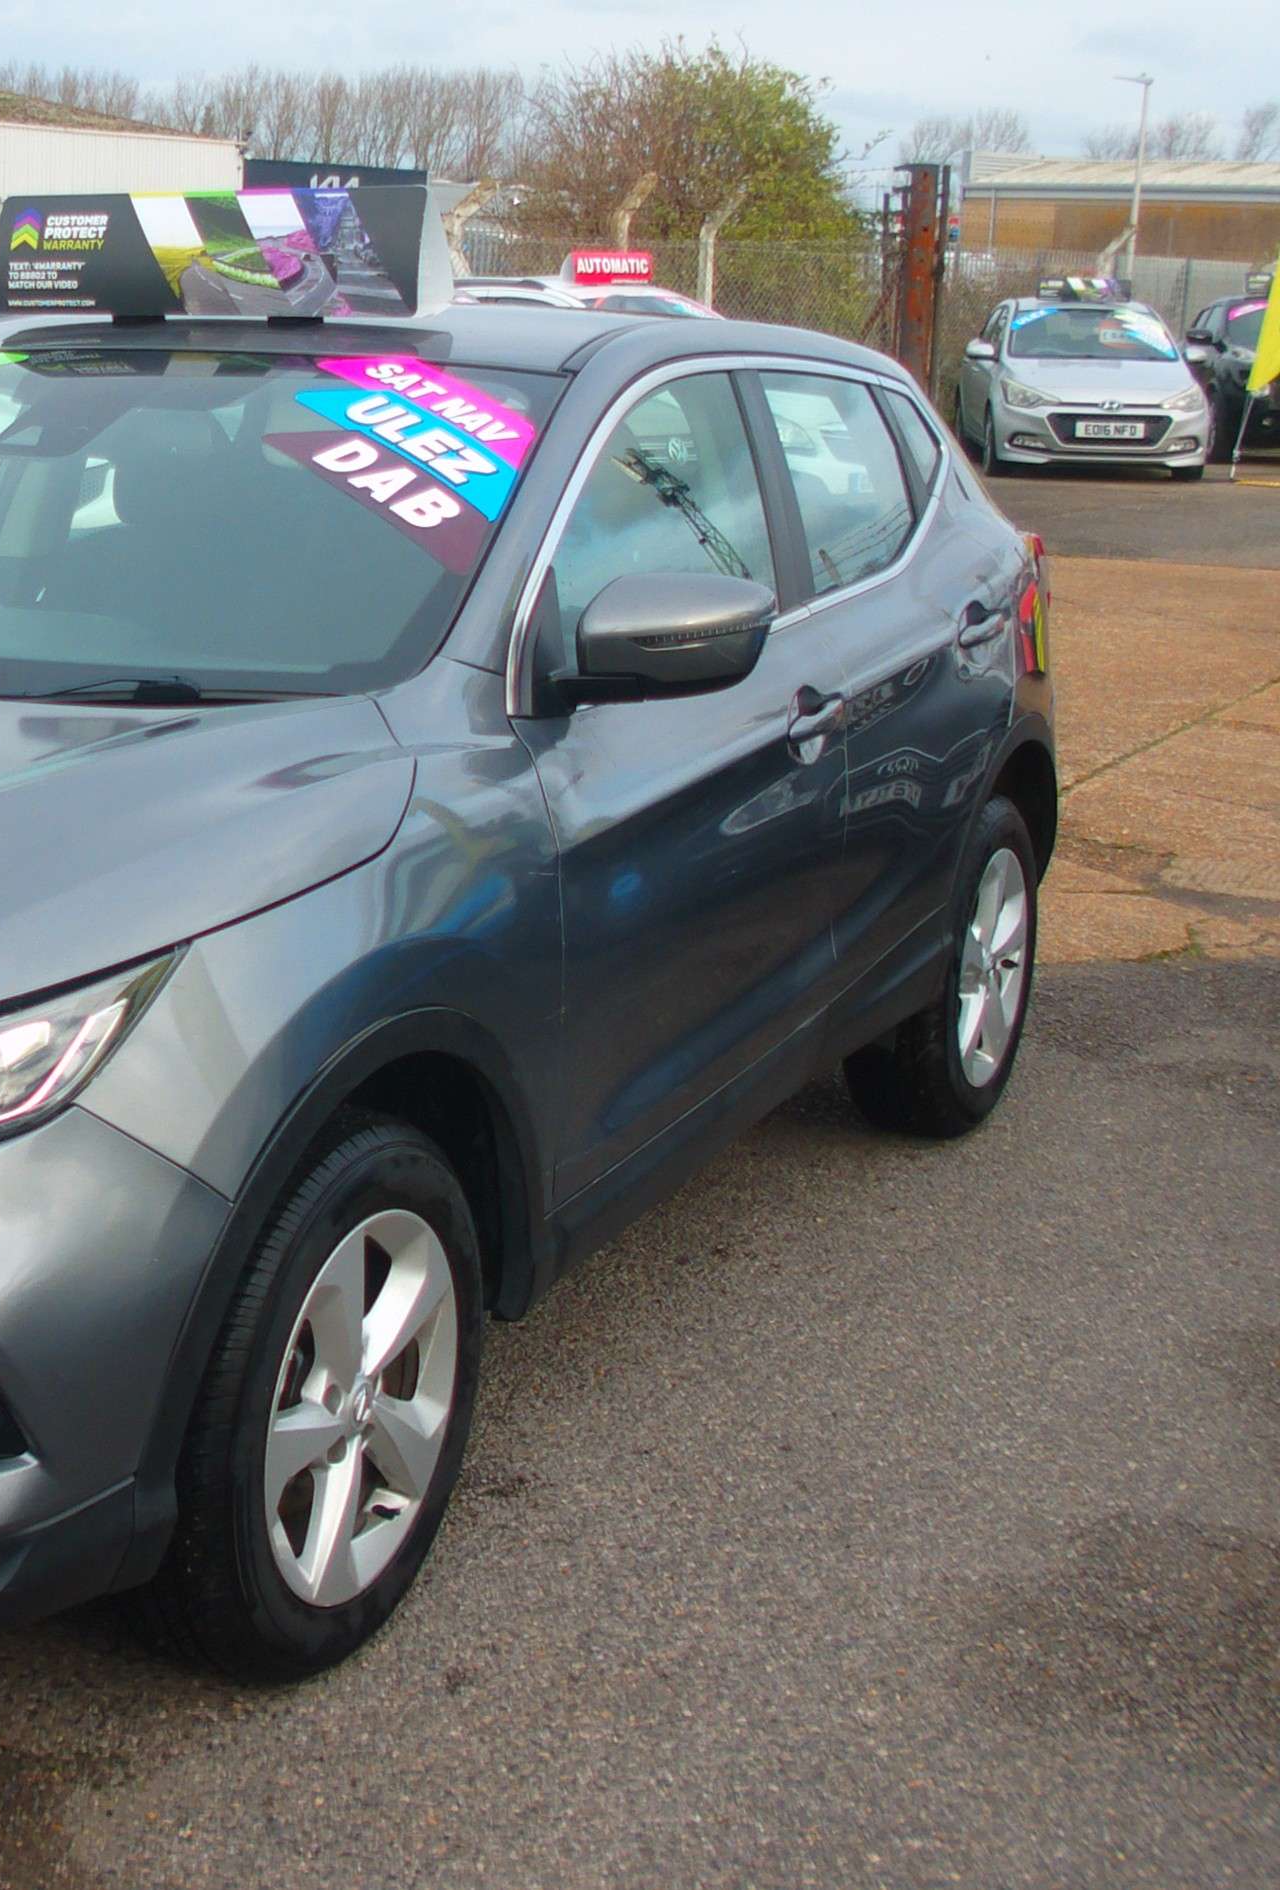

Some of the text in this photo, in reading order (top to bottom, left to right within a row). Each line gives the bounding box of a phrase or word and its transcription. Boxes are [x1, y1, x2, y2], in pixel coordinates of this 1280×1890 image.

[46, 215, 108, 226] CUSTOMER
[44, 227, 106, 239] PROTECT
[43, 240, 104, 250] WARRANTY
[576, 257, 648, 274] AUTOMATIC
[8, 272, 18, 280] TO
[47, 272, 57, 280] TO
[8, 281, 78, 289] WATCH OUR VIDEO
[365, 364, 520, 442] SAT NAV
[346, 396, 498, 485] ULEZ
[312, 440, 461, 528] DAB
